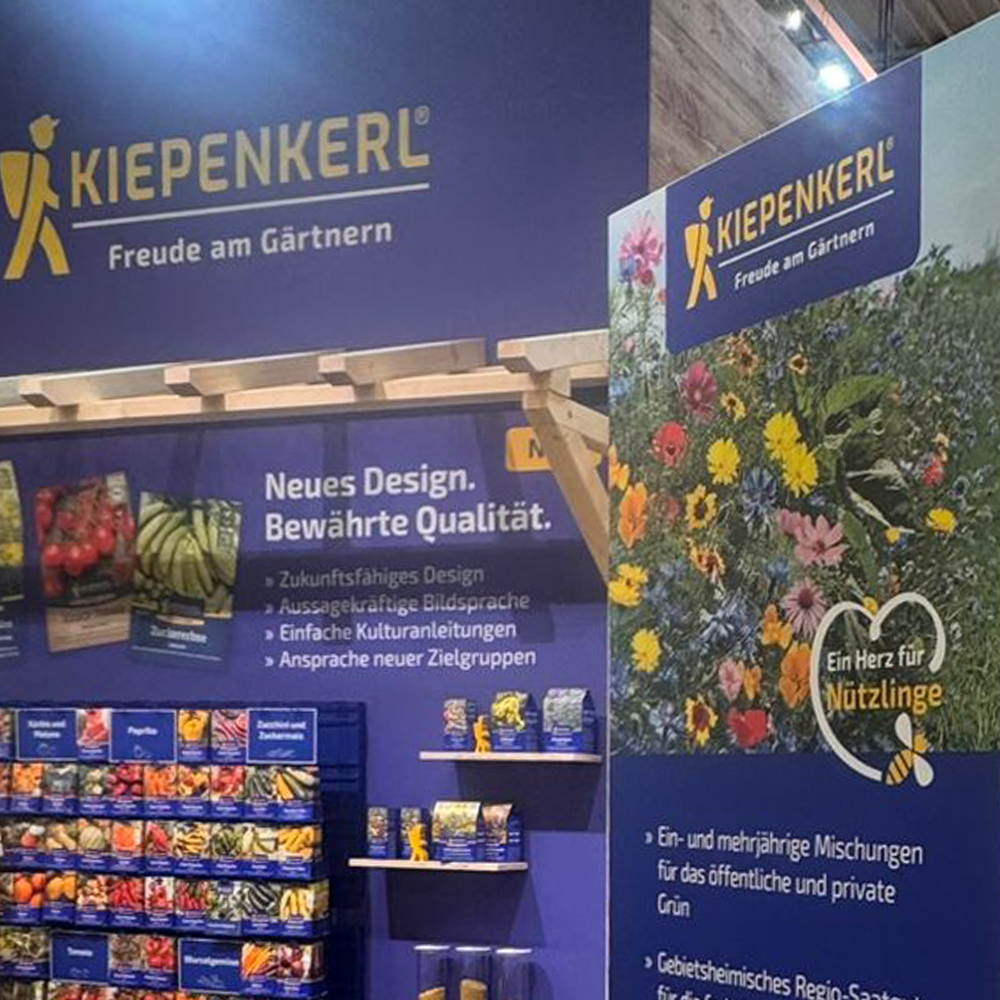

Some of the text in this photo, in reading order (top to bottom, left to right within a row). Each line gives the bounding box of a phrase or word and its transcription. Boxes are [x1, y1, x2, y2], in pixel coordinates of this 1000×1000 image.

[108, 221, 393, 270] Freude am Gärtnern
[733, 221, 876, 290] Freude am Gärtnern
[265, 463, 476, 500] Neues Design.
[265, 501, 552, 543] Bewährte Qualität.
[278, 565, 485, 590] Zukunftsfähiges Design
[278, 592, 531, 618] Aussagekräftige Bildsprache
[278, 620, 517, 643] Einfache Kulturanleitungen
[278, 648, 538, 672] Ansprache neuer Zielgruppen
[827, 644, 925, 673] Ein Herz für
[826, 678, 943, 715] Nützlinge
[656, 825, 924, 869] Ein- und mehrjährige Mischungen
[656, 859, 896, 904] für das öffentliche und private
[656, 893, 690, 918] Grün
[656, 952, 792, 996] Gebietsheimisches
